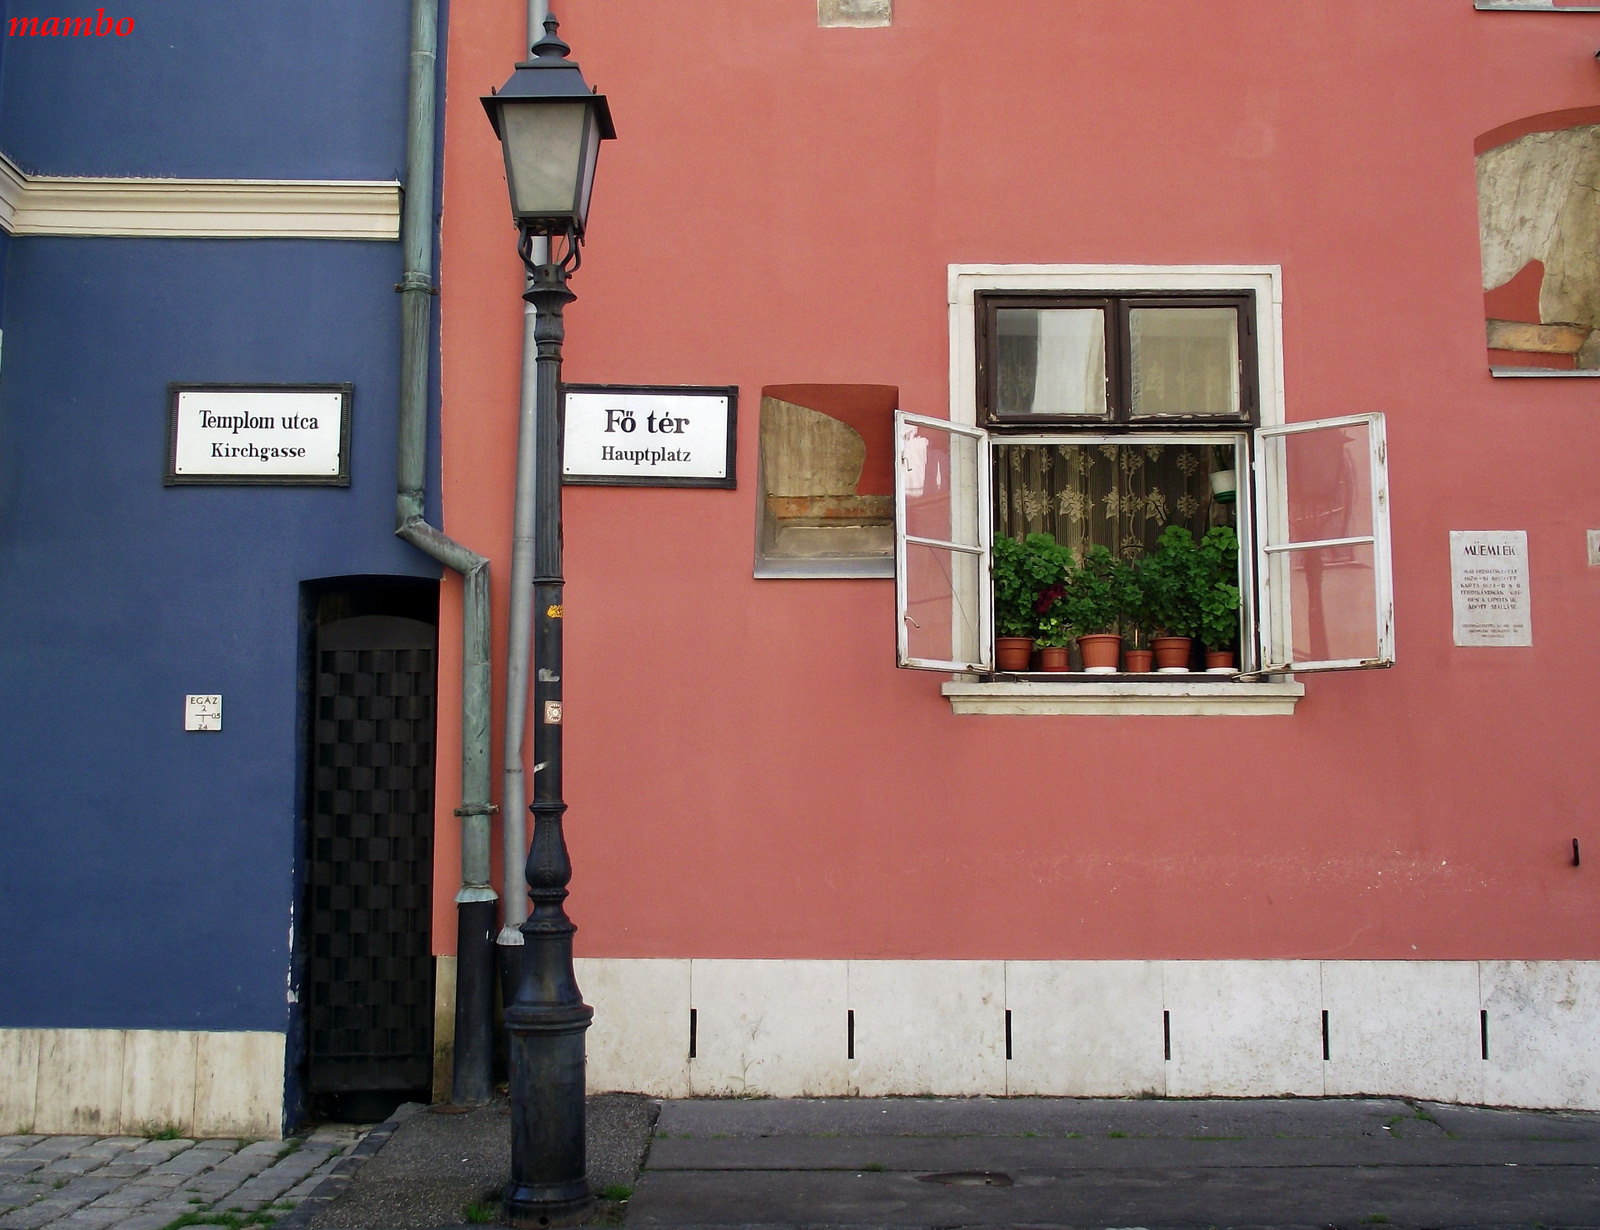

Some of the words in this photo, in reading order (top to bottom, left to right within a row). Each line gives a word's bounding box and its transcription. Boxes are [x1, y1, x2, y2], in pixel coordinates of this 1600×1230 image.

[199, 410, 275, 434] Templom
[281, 411, 319, 429] utca
[604, 409, 636, 433] Fő
[647, 410, 690, 433] tér
[211, 443, 306, 462] Kirchgasse
[601, 446, 691, 465] Hauptplatz
